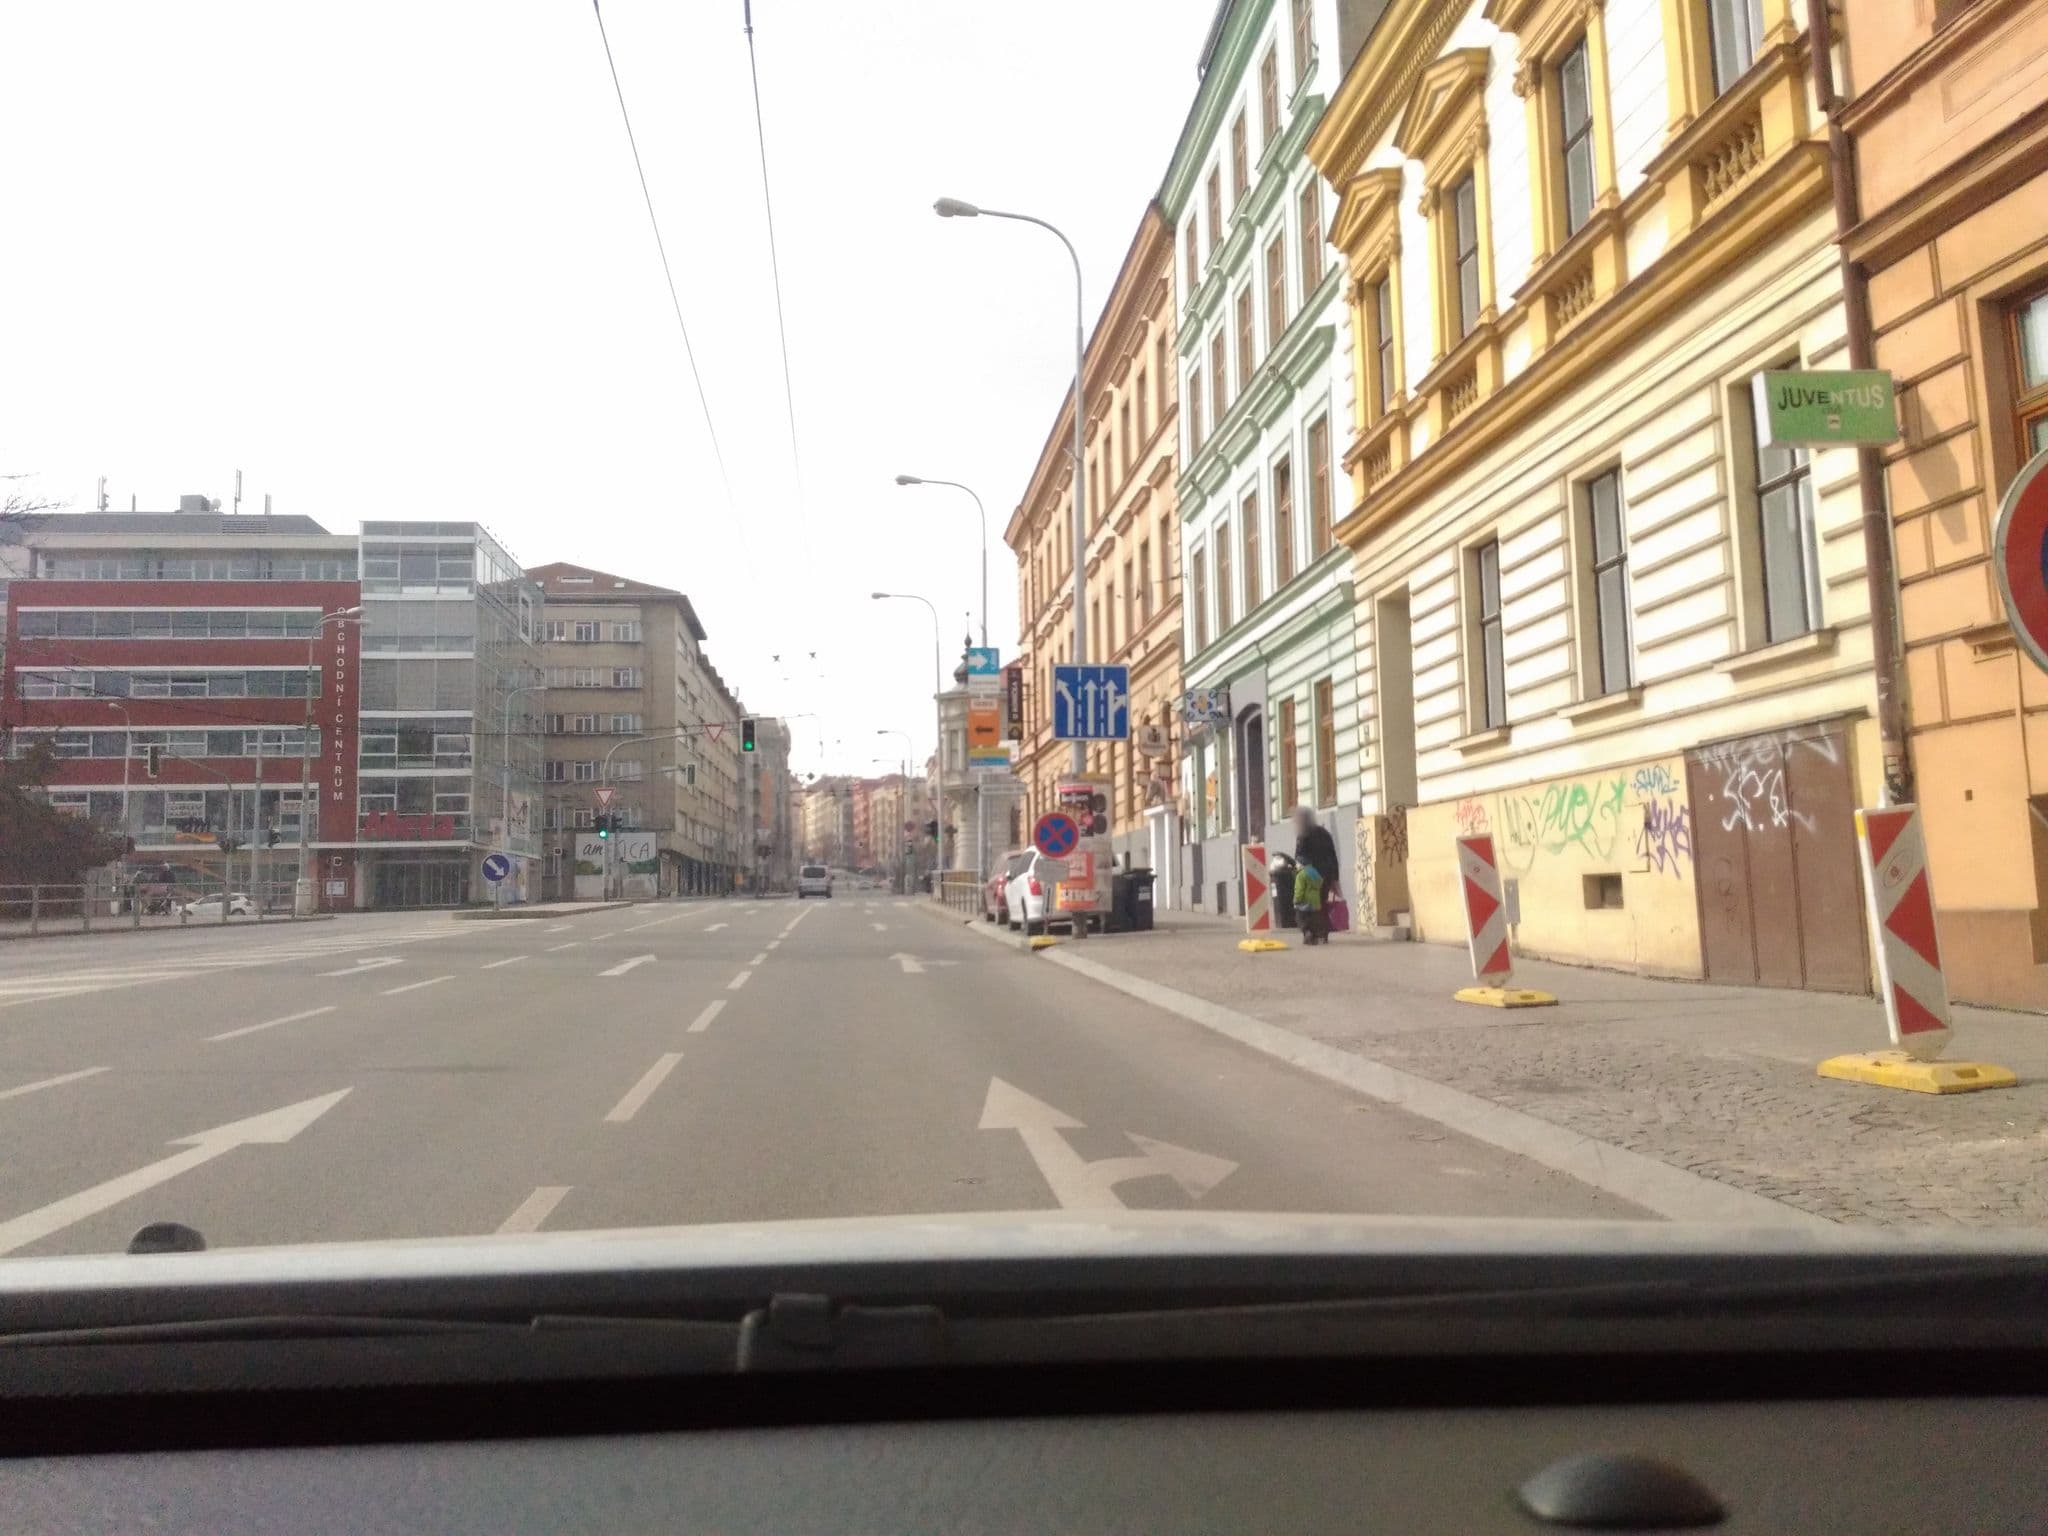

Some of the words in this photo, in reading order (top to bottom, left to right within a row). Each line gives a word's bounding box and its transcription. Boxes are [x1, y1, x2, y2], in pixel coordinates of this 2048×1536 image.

[1778, 385, 1885, 411] JUVENTUS
[336, 607, 346, 707] OBCHODNÍ
[333, 713, 344, 801] CENTRUM
